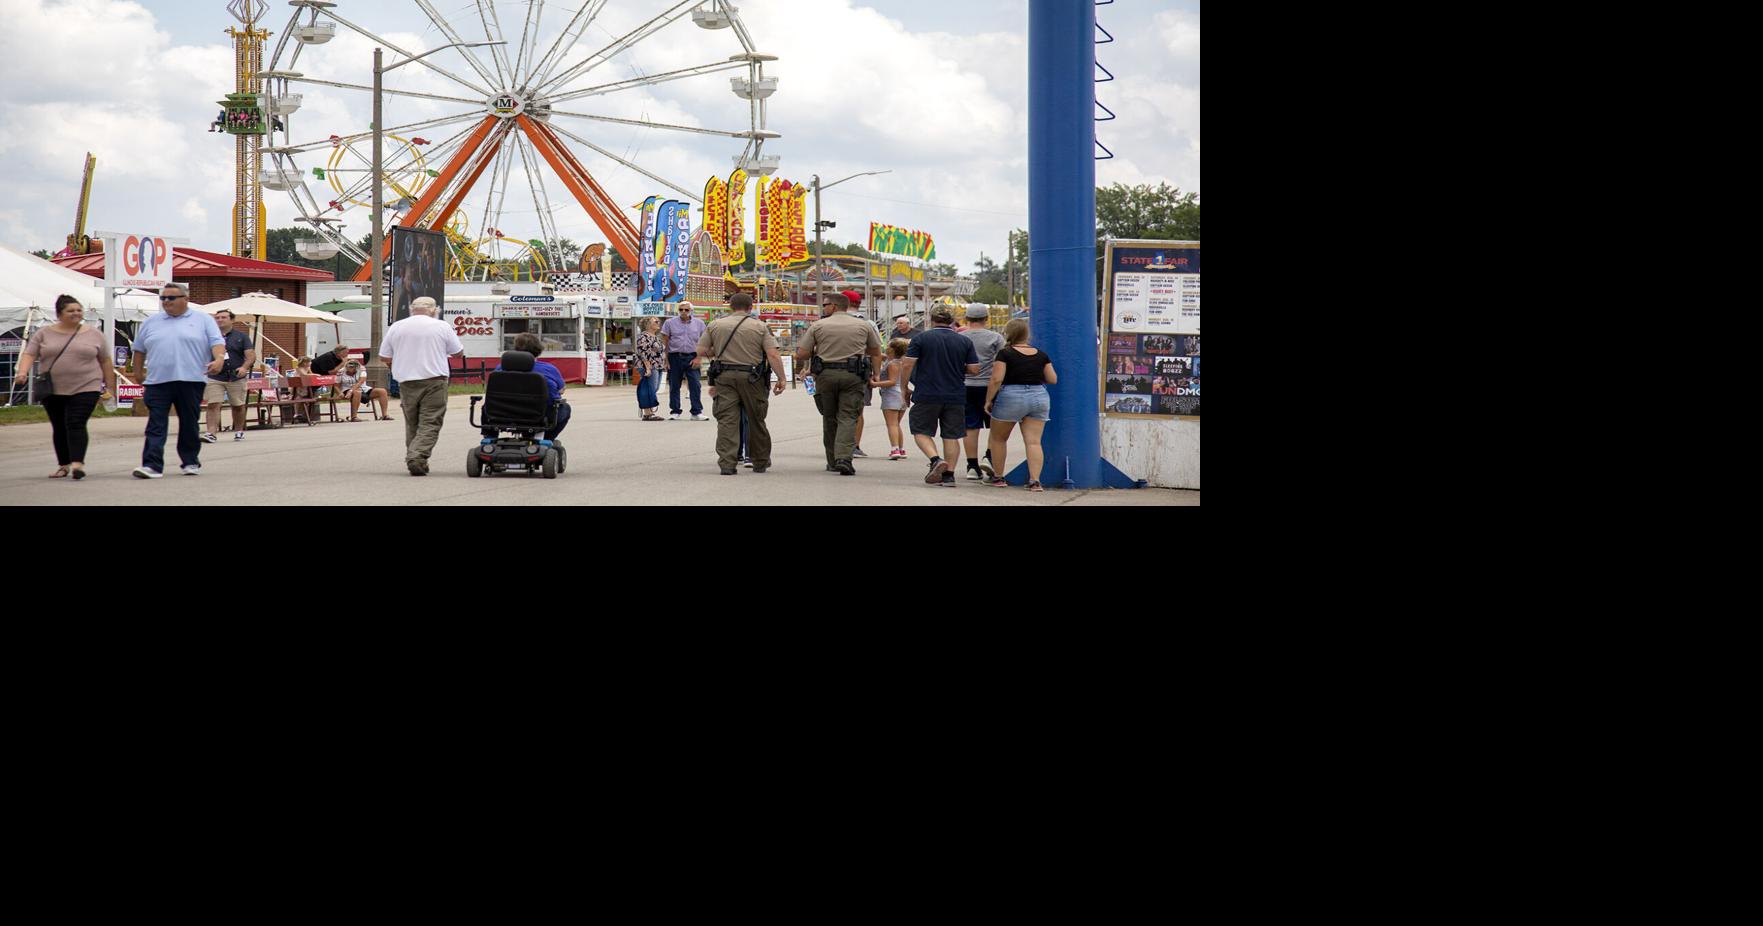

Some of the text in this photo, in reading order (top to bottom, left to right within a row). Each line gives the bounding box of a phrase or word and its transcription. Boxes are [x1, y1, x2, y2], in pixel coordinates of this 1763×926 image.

[499, 99, 513, 107] M
[123, 235, 167, 277] GOP
[454, 316, 495, 326] COZY
[454, 326, 495, 337] DOGS
